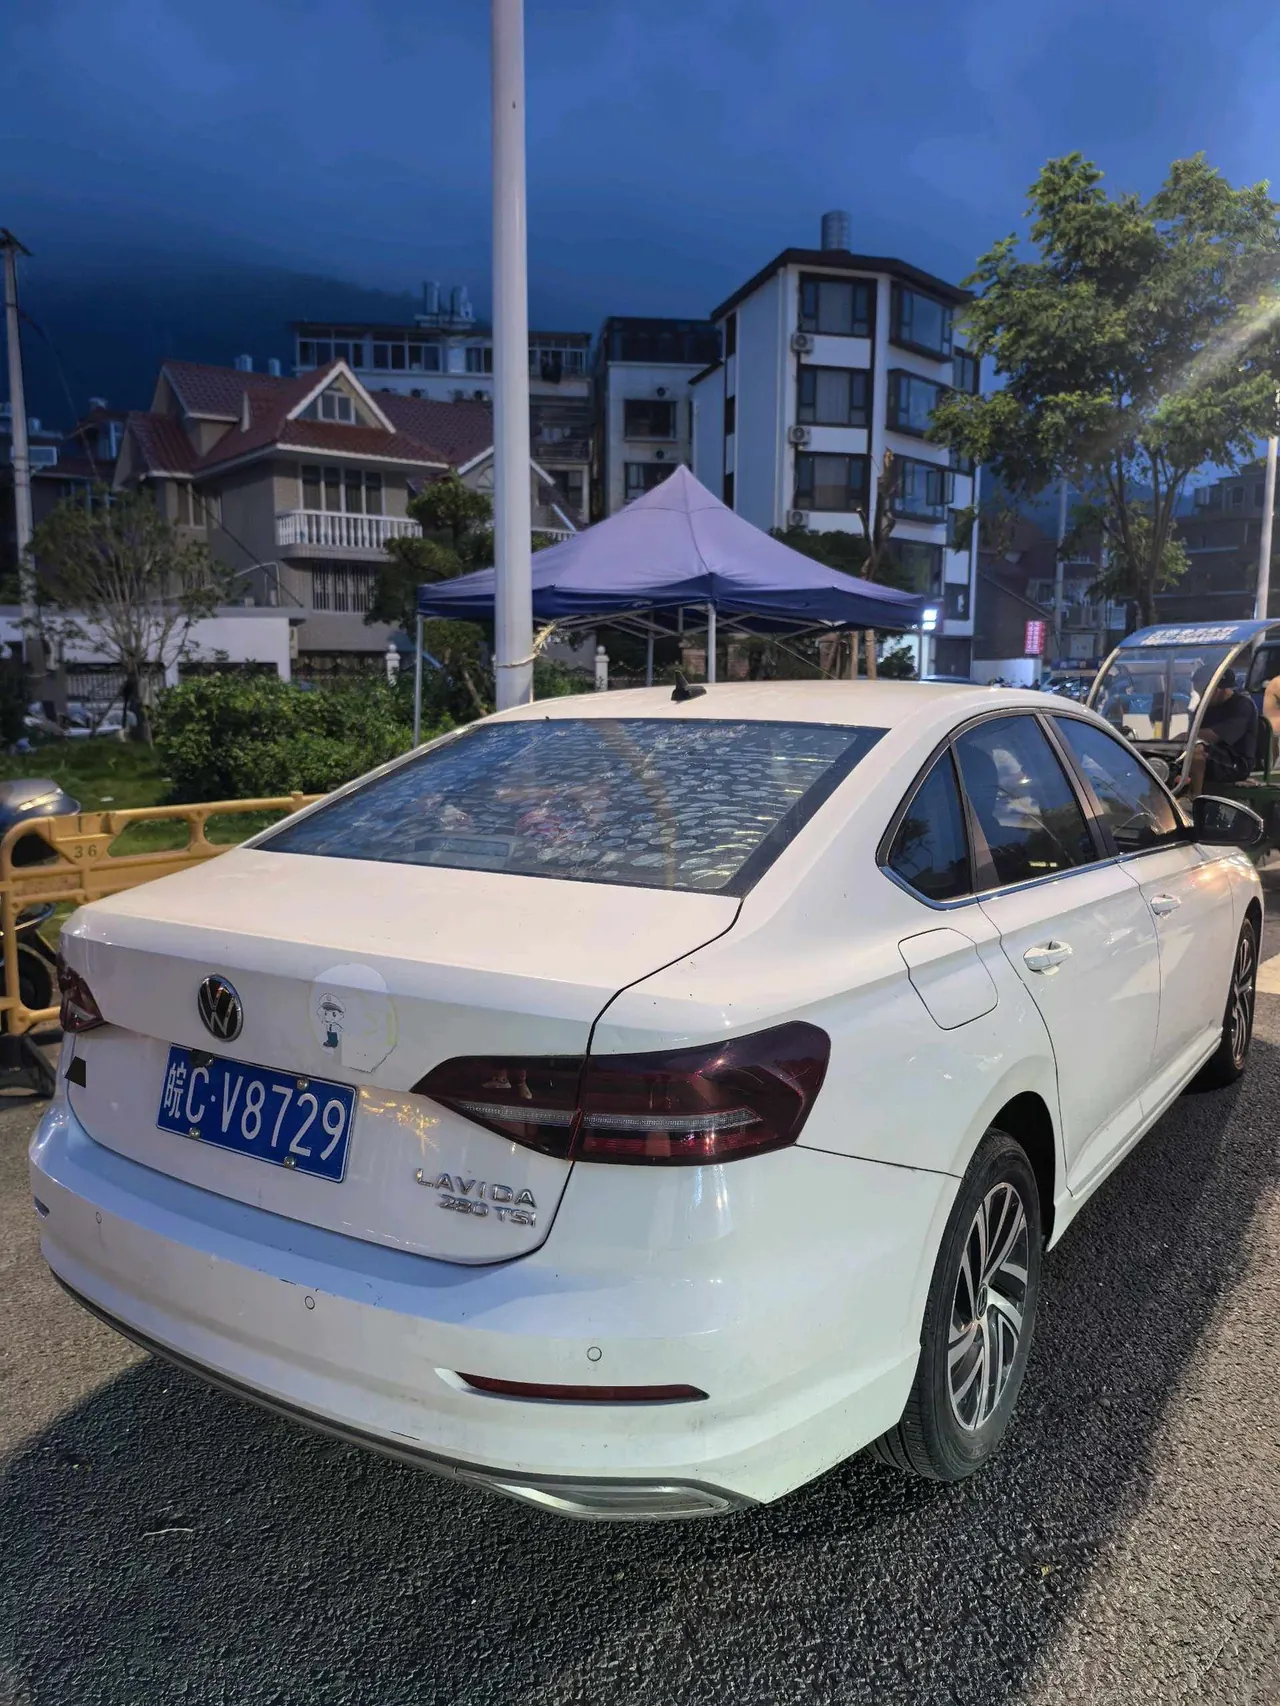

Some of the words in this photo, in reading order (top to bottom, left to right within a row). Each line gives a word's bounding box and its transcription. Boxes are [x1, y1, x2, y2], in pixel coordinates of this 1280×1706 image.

[416, 1168, 537, 1209] LAVIDA
[438, 1194, 489, 1217] 280
[493, 1206, 536, 1227] TSI
